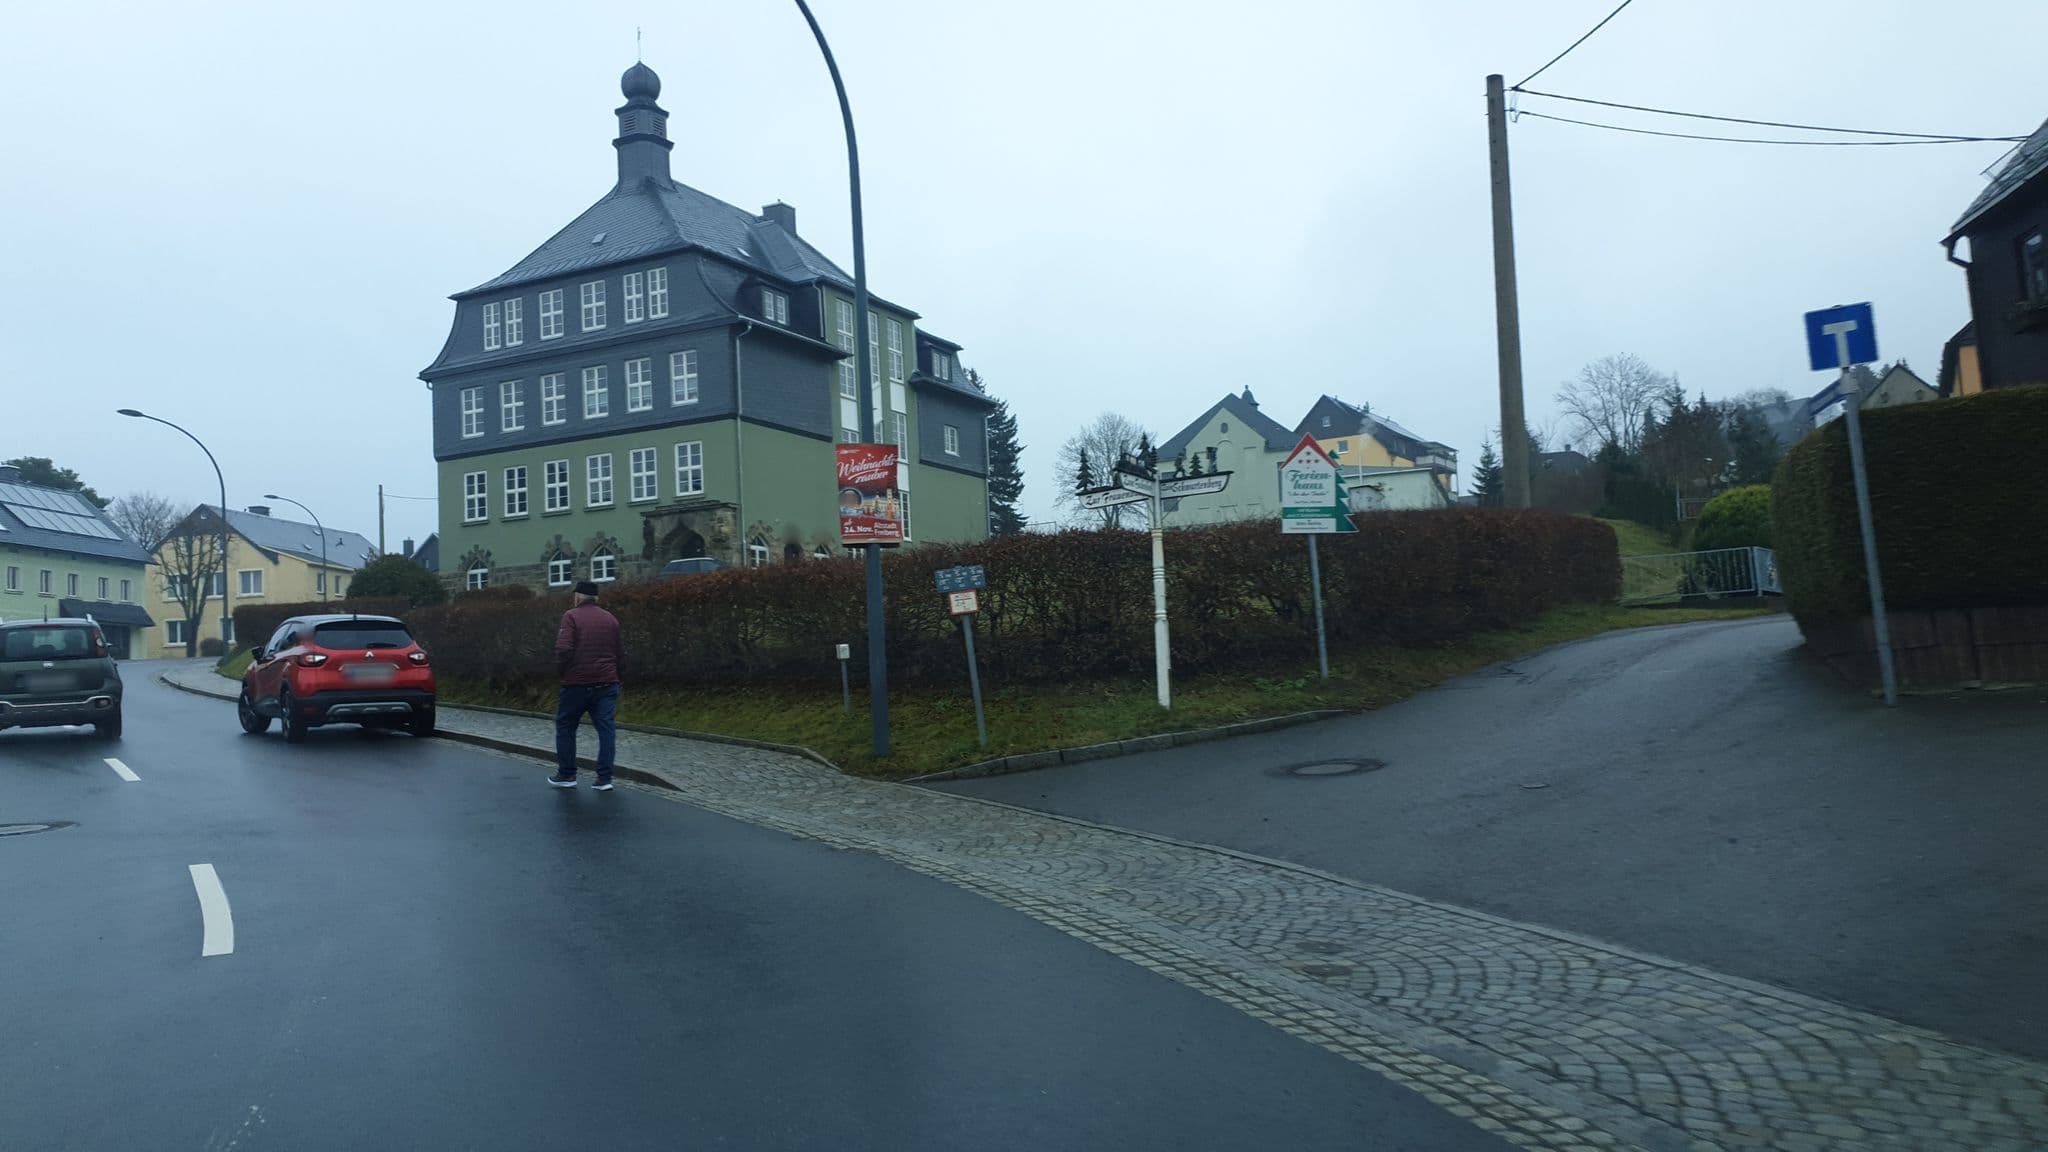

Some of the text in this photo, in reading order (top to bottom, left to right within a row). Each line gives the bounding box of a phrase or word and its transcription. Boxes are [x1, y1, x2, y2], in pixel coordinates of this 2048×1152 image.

[855, 469, 889, 484] zauber
[1288, 469, 1332, 483] Ferien-
[1294, 481, 1324, 490] haus
[857, 525, 874, 533] Nov.
[874, 528, 900, 538] Freiberg
